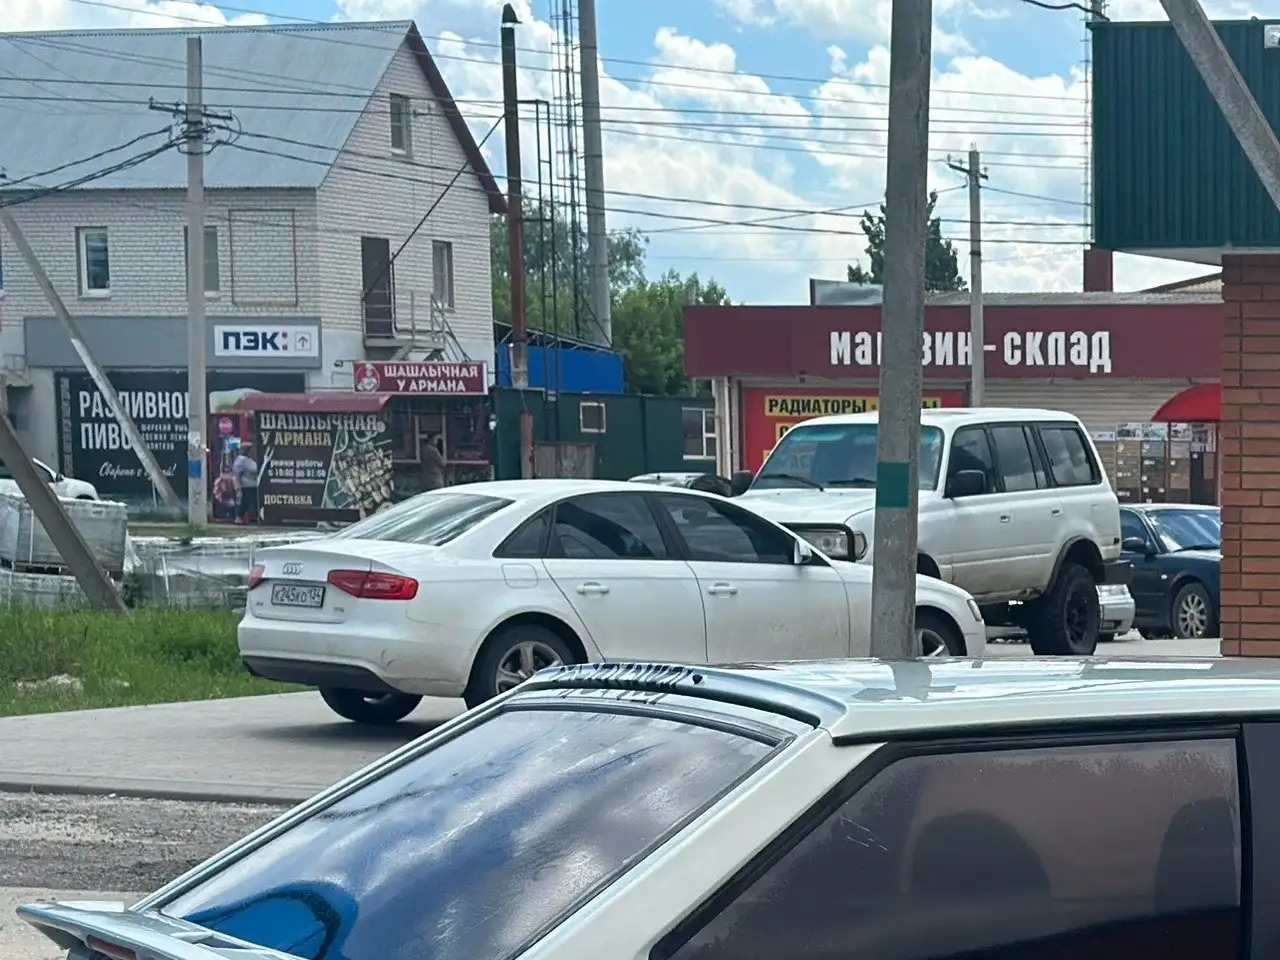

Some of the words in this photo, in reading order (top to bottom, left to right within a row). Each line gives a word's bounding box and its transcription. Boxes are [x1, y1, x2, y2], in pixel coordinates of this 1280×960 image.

[384, 365, 478, 378] ШАШЛЫЧНАЯ
[397, 379, 405, 392] У
[409, 379, 466, 392] АРМАНА
[768, 398, 867, 415] РАДИАТОРЫ
[260, 413, 377, 430] ШАШЛЫЧНАЯ
[261, 432, 270, 446] У
[275, 432, 332, 446] АРМАНА
[264, 494, 312, 505] ДОСТАВКА
